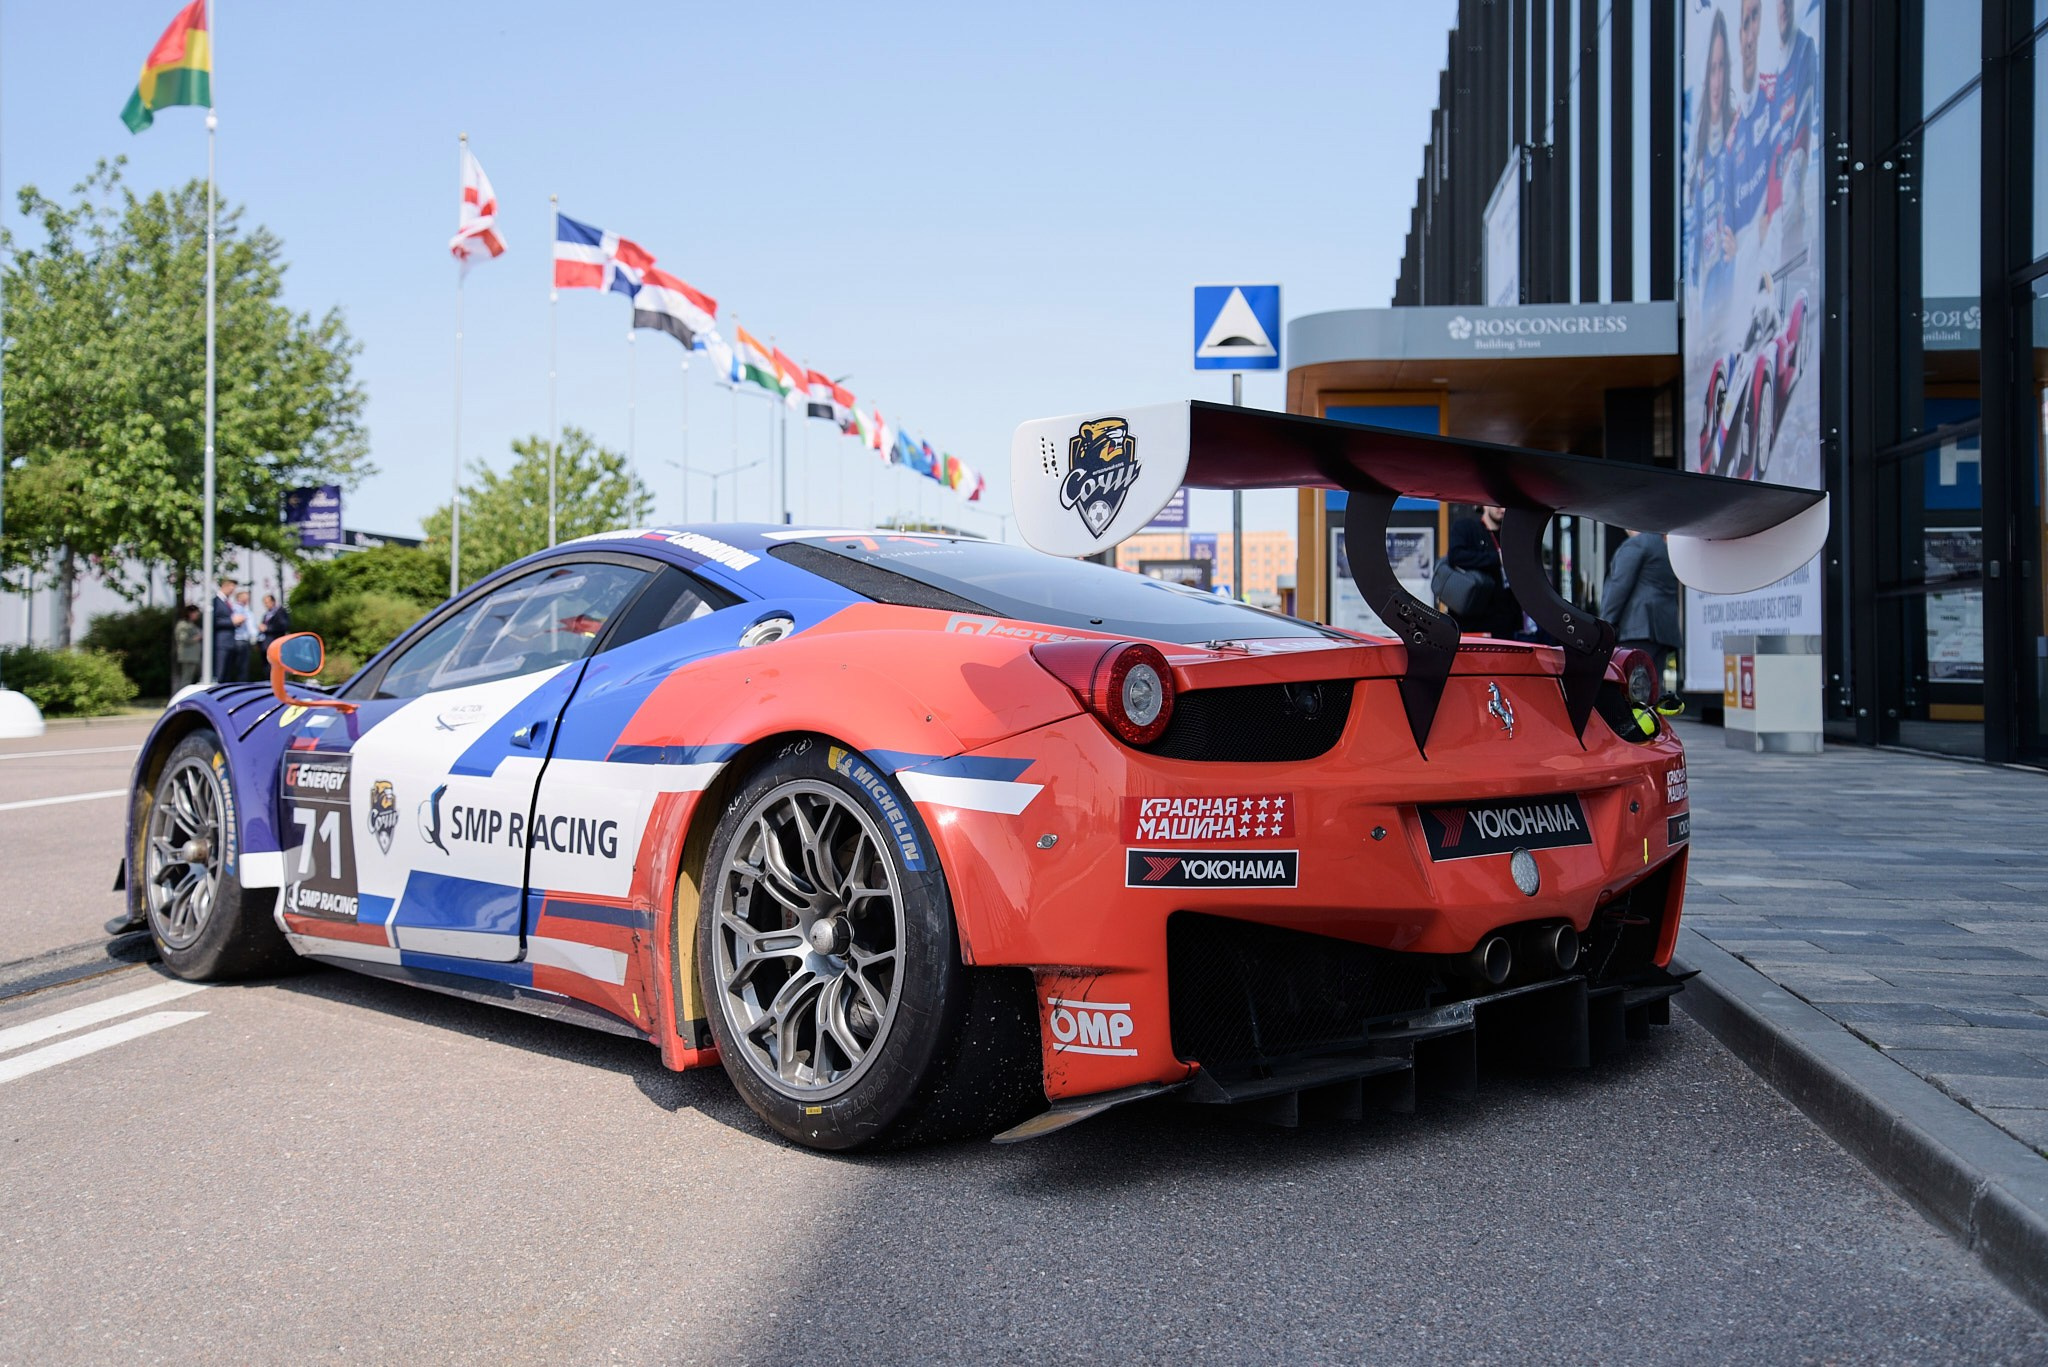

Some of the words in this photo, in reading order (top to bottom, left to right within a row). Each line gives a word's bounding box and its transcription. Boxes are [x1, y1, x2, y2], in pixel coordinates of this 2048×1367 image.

[1475, 316, 1628, 336] ROSCONGRESS
[1475, 339, 1516, 351] Building
[1518, 339, 1541, 349] Trust
[220, 778, 236, 867] MICHELIN
[853, 766, 920, 861] MICHELIN
[1140, 798, 1238, 817] КРАСНАЯ
[1468, 804, 1580, 839] YOKOHAMA
[293, 807, 342, 880] 71
[451, 805, 502, 844] SMP
[509, 812, 618, 859] RACING
[1136, 817, 1236, 840] МАШИНА
[1181, 860, 1286, 879] YOKOHAMA
[299, 888, 320, 910] SMP
[320, 891, 358, 916] RACING
[1050, 1008, 1134, 1047] OMP
